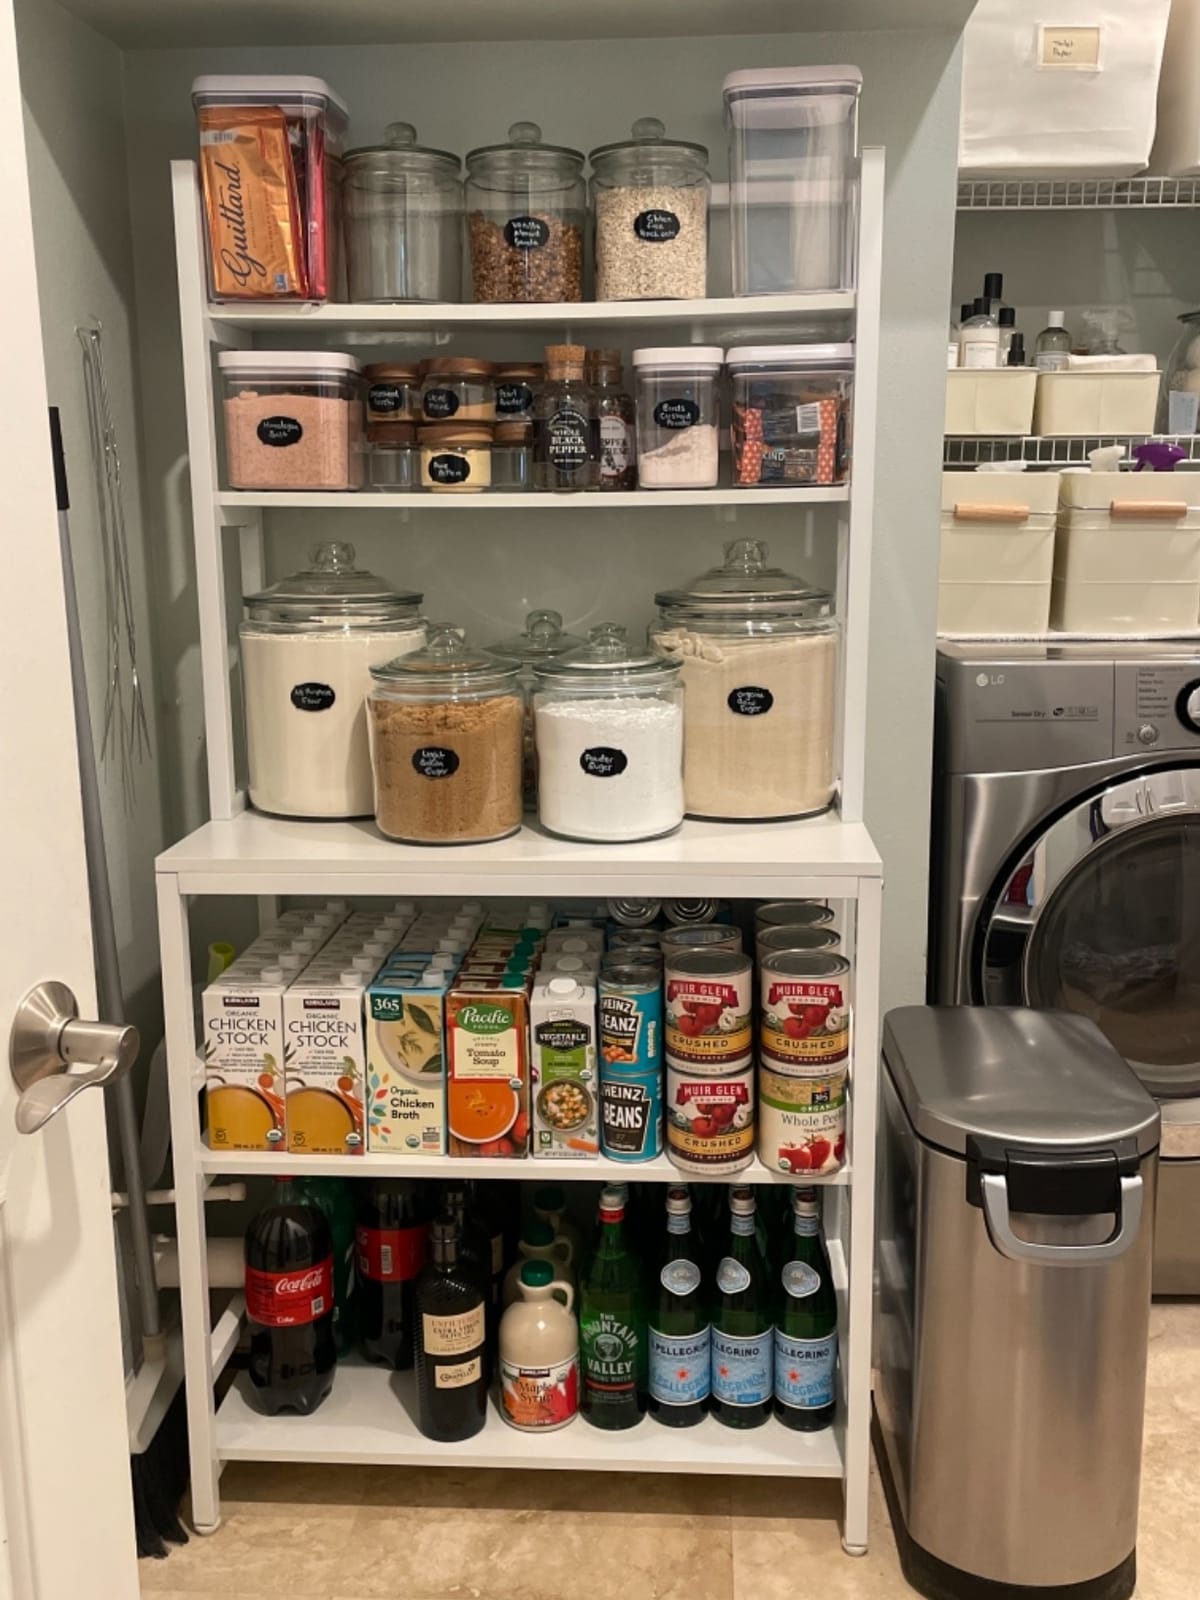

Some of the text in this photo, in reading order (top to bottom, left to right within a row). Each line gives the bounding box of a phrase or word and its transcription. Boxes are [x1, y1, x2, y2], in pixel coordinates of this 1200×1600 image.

[214, 161, 267, 287] Guittard
[551, 436, 584, 445] BLACK
[549, 445, 587, 454] PEPPER
[762, 451, 785, 461] KIND
[1033, 710, 1046, 718] Dry
[673, 983, 729, 997] MUIR GLEN
[776, 985, 836, 997] MUIR GLEN
[374, 998, 400, 1011] 365
[461, 1006, 509, 1024] Pacific
[208, 1018, 276, 1032] CHICKEN
[288, 1021, 357, 1034] CHICKEN
[217, 1032, 269, 1046] STOCK
[297, 1035, 349, 1048] STOCK
[539, 1033, 587, 1041] VEGETABLE
[672, 1034, 729, 1048] CRUSHED
[776, 1038, 835, 1049] CRUSHED
[466, 1048, 506, 1057] Tomato
[473, 1057, 500, 1068] Soup
[390, 1087, 419, 1097] Organic
[602, 1084, 642, 1101] HEINZ
[684, 1085, 743, 1096] MUIR GLEN
[390, 1098, 434, 1109] Chicken
[800, 1103, 838, 1113] ORGANIC
[391, 1110, 420, 1120] Broth
[603, 1102, 643, 1129] BEANS
[781, 1113, 819, 1126] Whole
[684, 1136, 741, 1148] CRUSHED
[600, 1312, 615, 1321] THE
[582, 1321, 639, 1348] MOUNTAIN
[587, 1357, 633, 1374] VALLEY
[519, 1382, 552, 1395] Maple
[520, 1392, 553, 1405] Syrup
